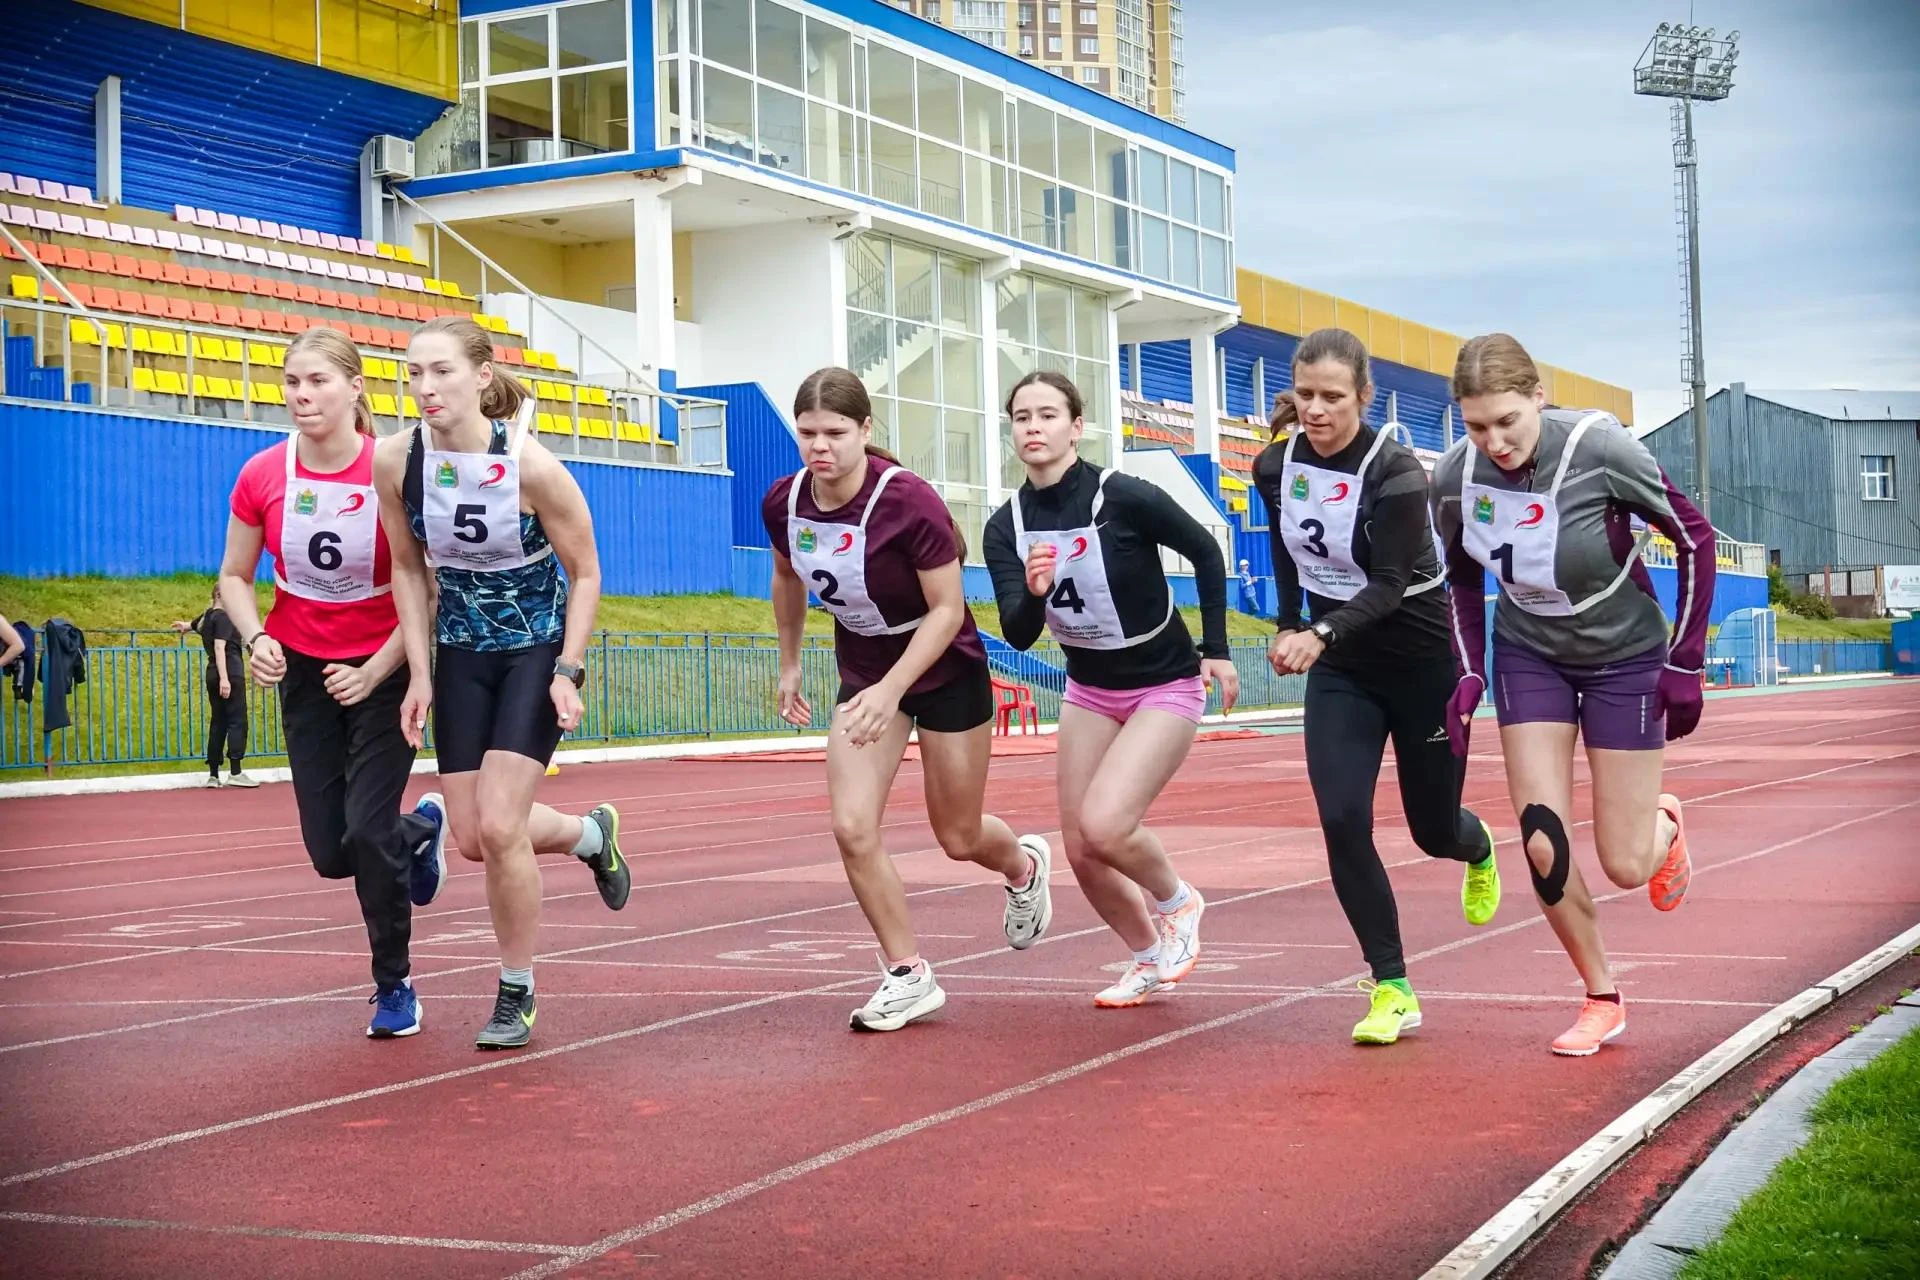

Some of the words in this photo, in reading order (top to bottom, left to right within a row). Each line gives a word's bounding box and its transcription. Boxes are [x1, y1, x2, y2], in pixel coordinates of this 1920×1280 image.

[453, 503, 489, 544] 5
[1299, 518, 1329, 559] 3
[307, 530, 343, 571] 6
[1489, 542, 1515, 585] 1
[811, 569, 848, 607] 2
[1050, 577, 1085, 614] 4
